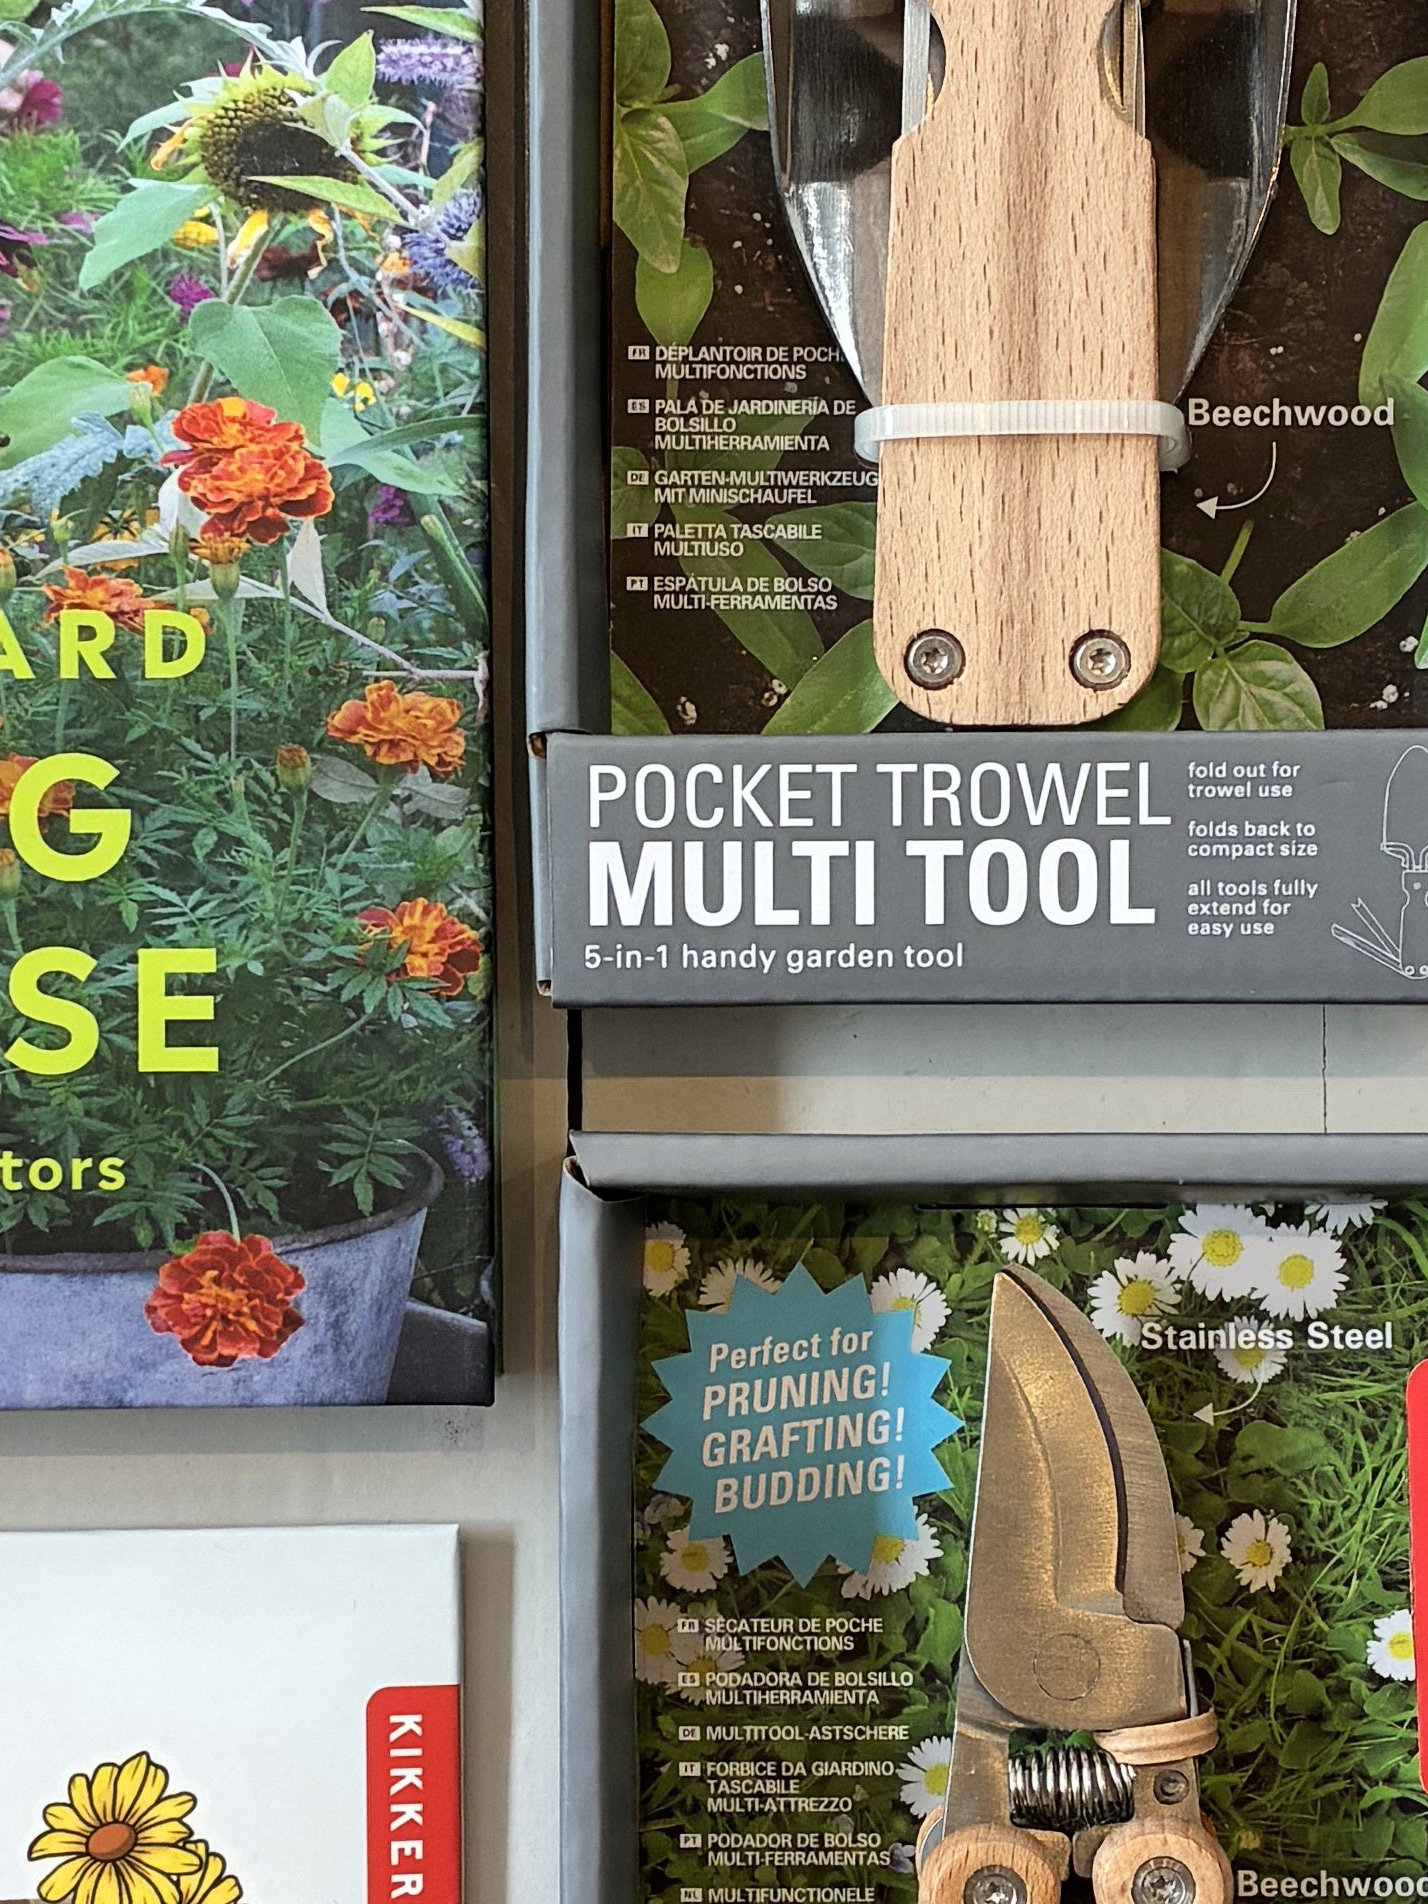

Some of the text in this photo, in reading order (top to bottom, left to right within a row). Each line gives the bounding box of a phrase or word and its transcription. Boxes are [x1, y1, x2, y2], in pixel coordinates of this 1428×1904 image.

[656, 344, 844, 362] DÉPLANTOIR DE POCH
[656, 364, 806, 380] MULTIFONCTIONS
[655, 398, 856, 415] PALA DE JARDINERÍA DE
[1188, 397, 1395, 427] Beechwood
[655, 418, 736, 432] BOLSILLO
[655, 436, 829, 451] MULTIHERRAMIENTA
[655, 471, 878, 486] GARTEN-MULTIWERKZEUG
[654, 489, 816, 504] MIT MINISCHAUFEL
[654, 524, 822, 539] PALETTA TASCABILE
[654, 542, 743, 557] MULTIUSO
[1189, 761, 1301, 778] fold out for
[588, 762, 1171, 827] POCKET TROWEL
[1188, 781, 1292, 797] trowel use
[1188, 820, 1315, 837] folds back to
[1188, 840, 1317, 859] compact size
[590, 839, 1155, 926] MULTI TOOL
[1188, 880, 1317, 898] all tools fully
[1188, 899, 1291, 915] extend for
[1188, 923, 1274, 937] easy use
[586, 943, 962, 973] 5-in-1 handy garden tool
[1141, 1321, 1392, 1350] Stainless Steel
[710, 1327, 873, 1378] Perfect for
[703, 1362, 890, 1421] PRUNING!
[702, 1408, 905, 1468] GRAFTING!
[715, 1456, 905, 1514] BUDDING!
[706, 1672, 913, 1686] PODADORA DE BOLSILLO
[706, 1690, 880, 1705] MULTIHERRAMIENTA
[706, 1726, 909, 1741] MULTITOOL-ASTSCHERE
[708, 1834, 881, 1848] PODADOR DE BOLSO
[708, 1851, 890, 1866] MULTI-FERRAMENTAS
